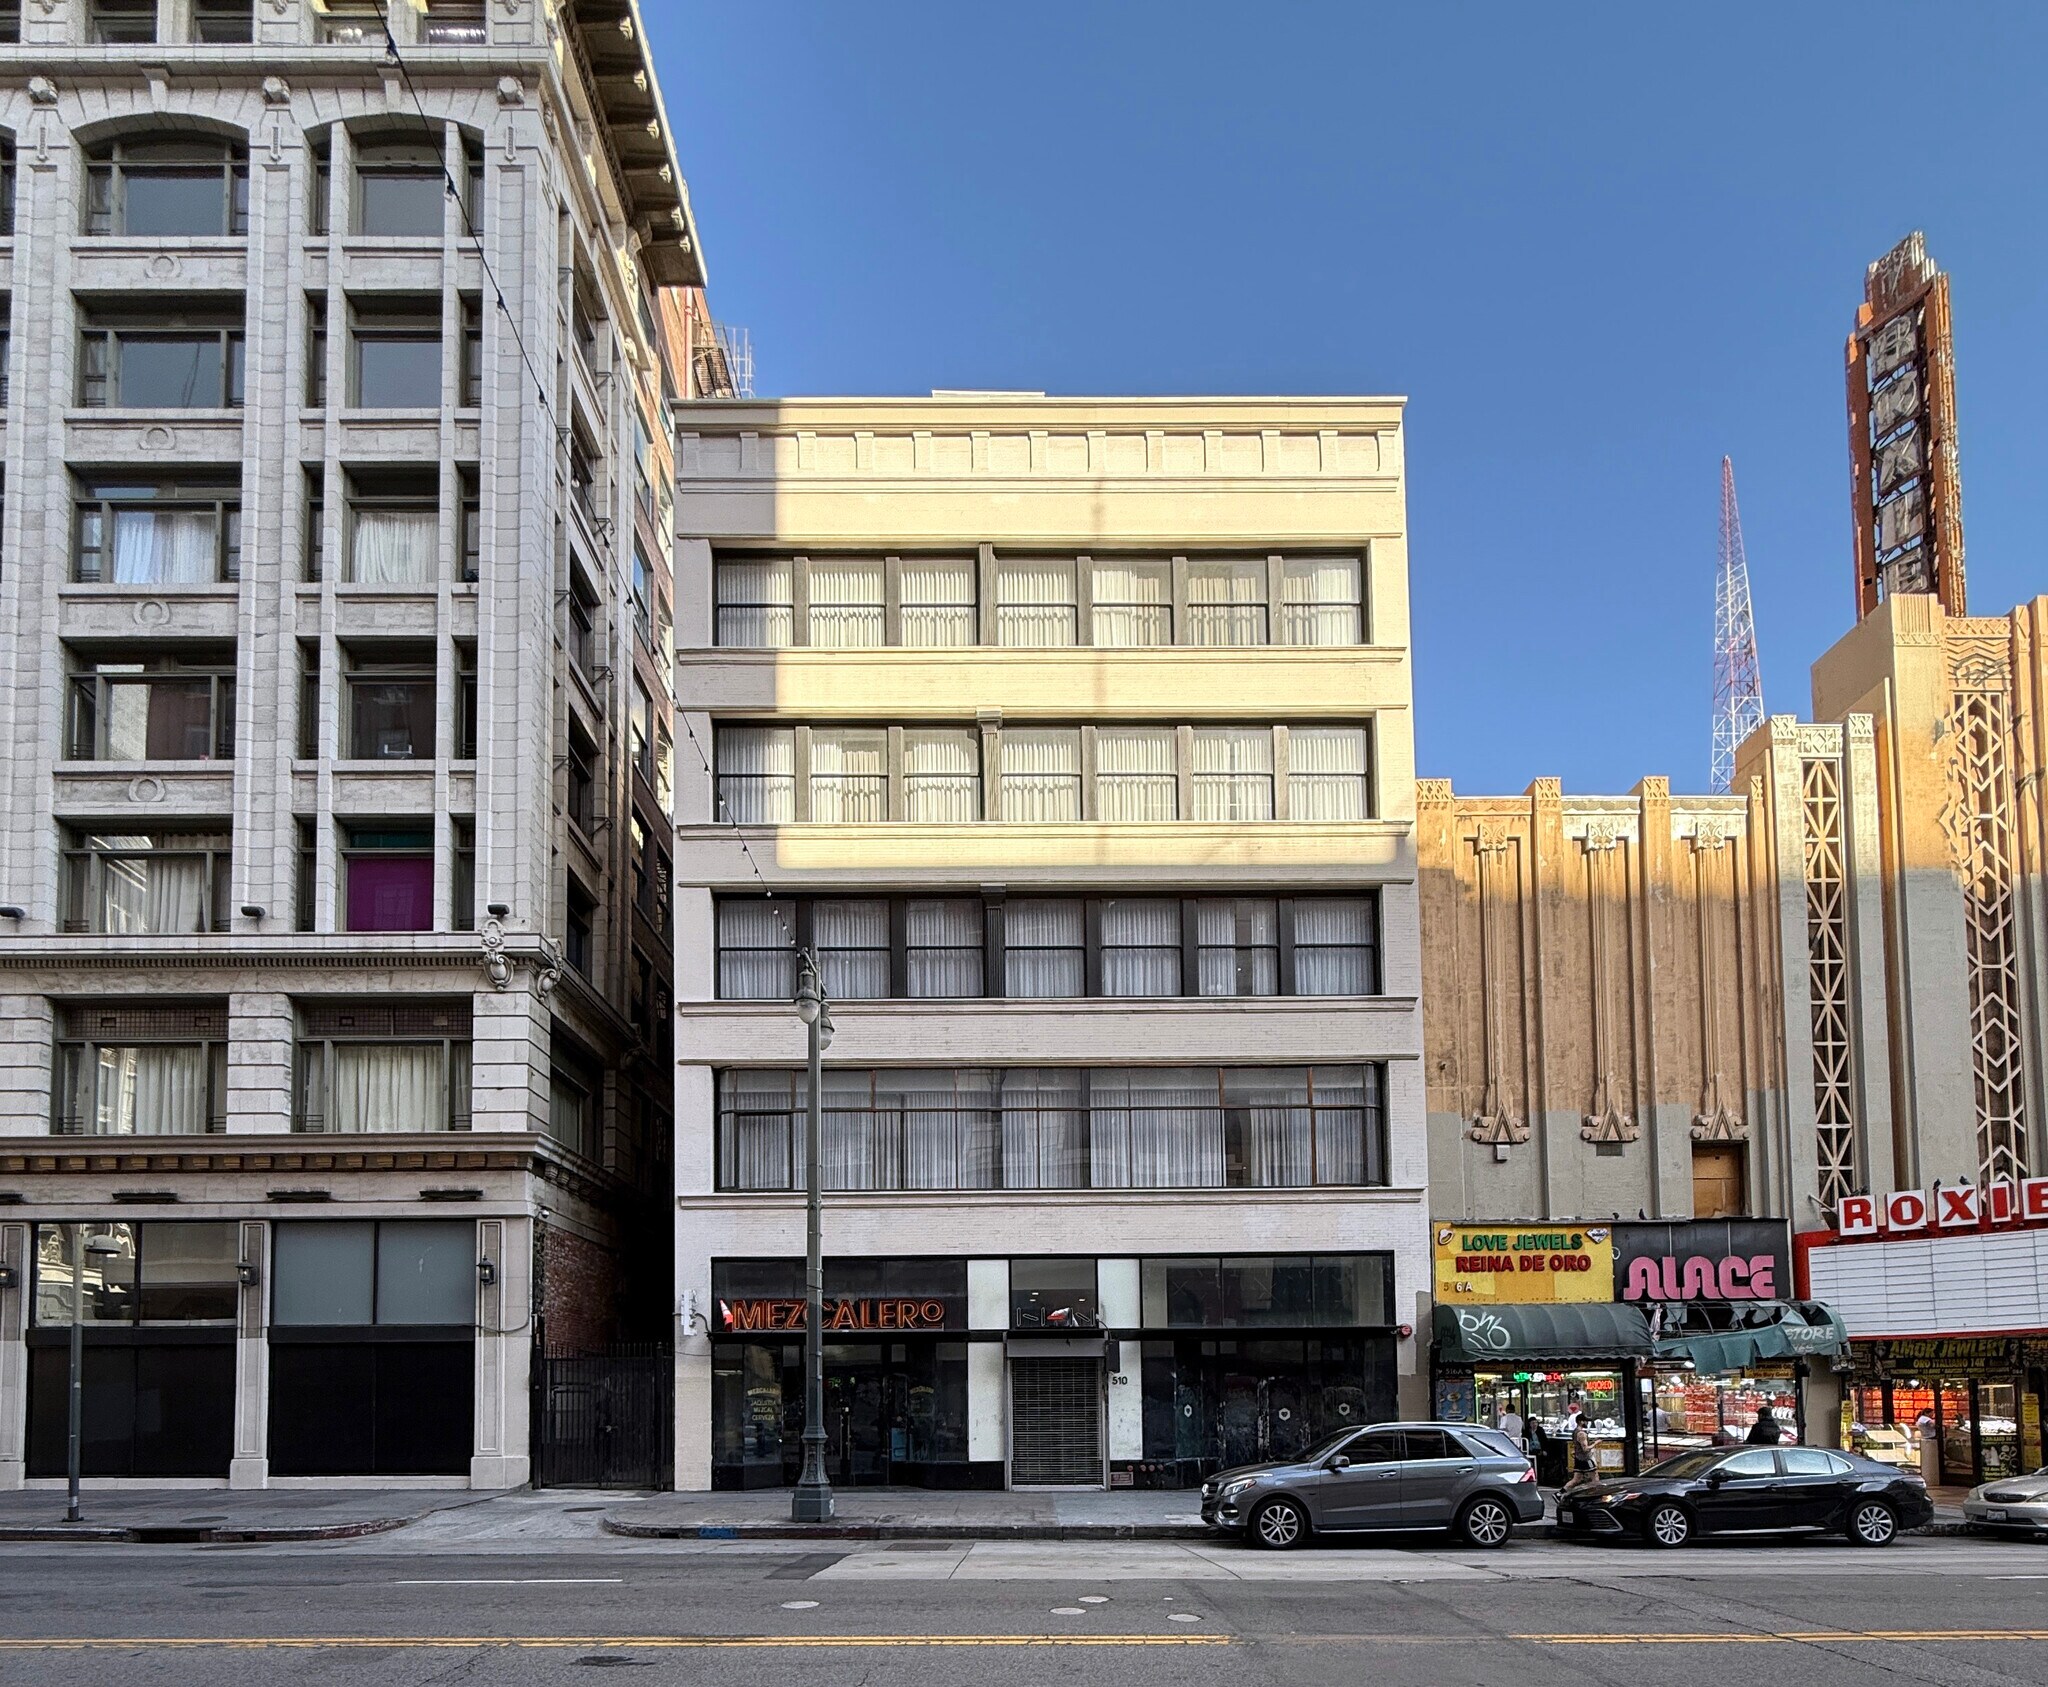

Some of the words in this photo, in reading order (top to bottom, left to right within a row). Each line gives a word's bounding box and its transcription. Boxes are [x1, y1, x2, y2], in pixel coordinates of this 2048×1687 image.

[1843, 1182, 2048, 1229] ROXIE
[1462, 1234, 1508, 1251] LOVE
[1513, 1233, 1583, 1251] JEWELS
[1455, 1256, 1515, 1273] REINA
[1519, 1255, 1545, 1272] DE
[1549, 1254, 1592, 1272] ORO
[732, 1298, 945, 1331] MEZCALERO
[1785, 1327, 1835, 1341] STORE
[1888, 1340, 1938, 1358] AMOR
[1940, 1338, 2007, 1357] JEWLERY
[1913, 1359, 1931, 1368] ORO
[1932, 1358, 1969, 1368] ITALIANO
[1971, 1358, 1986, 1368] 14K
[1111, 1376, 1128, 1385] 510
